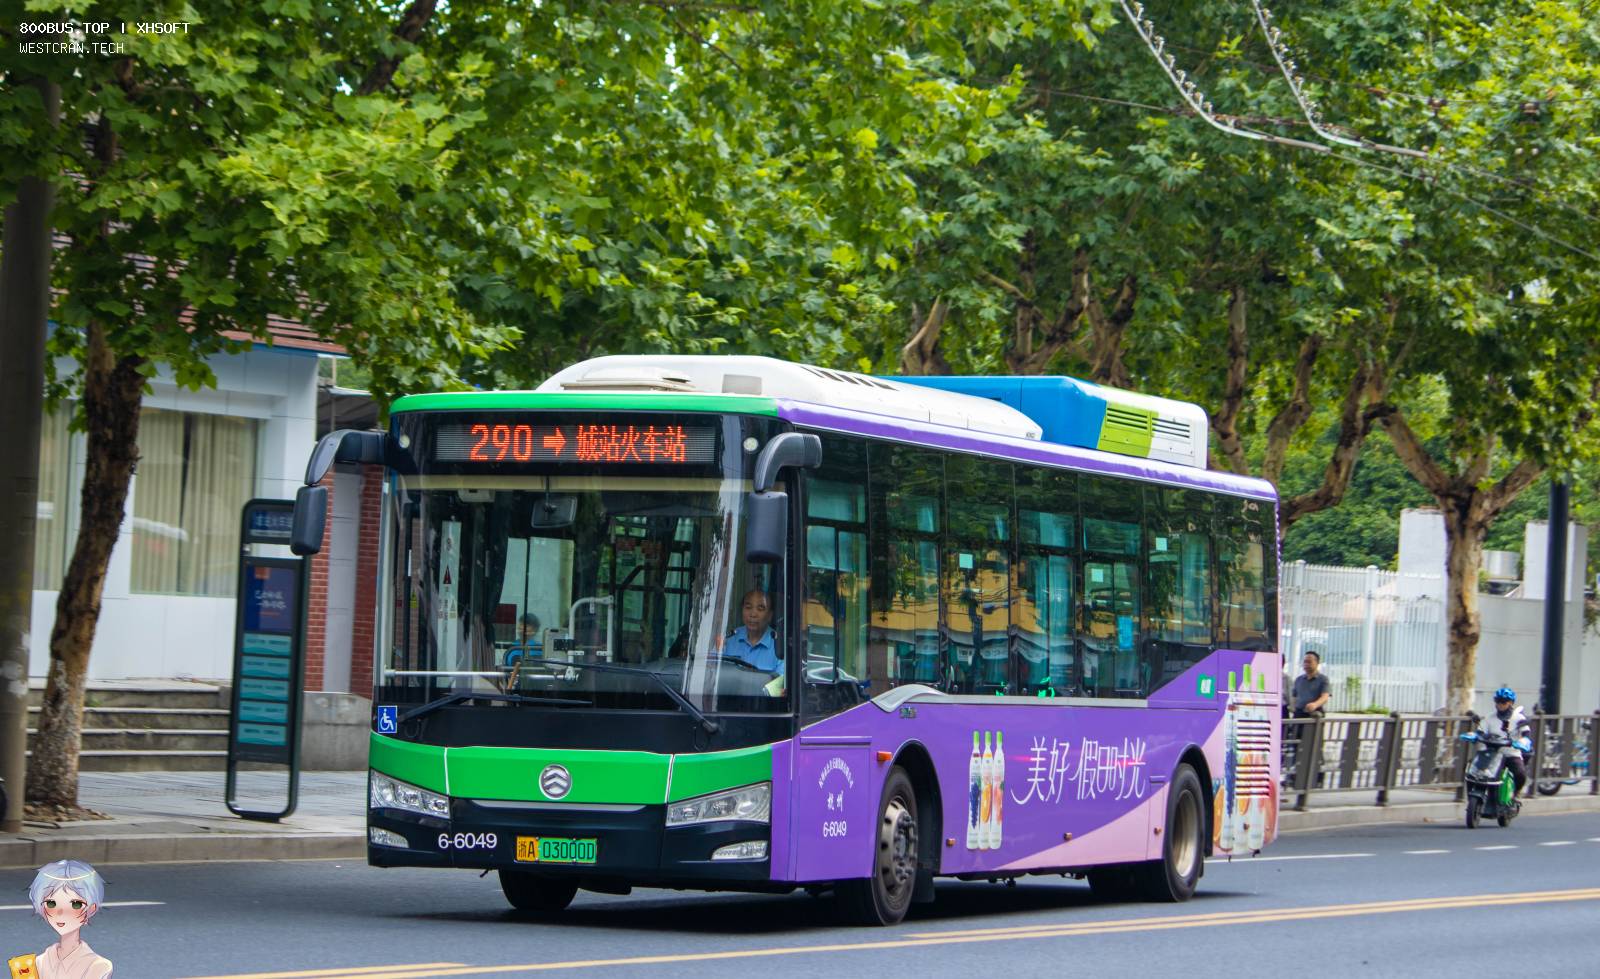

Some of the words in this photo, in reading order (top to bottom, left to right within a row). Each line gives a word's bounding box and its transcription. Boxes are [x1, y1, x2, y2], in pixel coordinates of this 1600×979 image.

[470, 424, 533, 461] 290
[575, 425, 688, 462] 城站火车站
[823, 820, 847, 837] 6-6049
[437, 832, 498, 849] 6-6049
